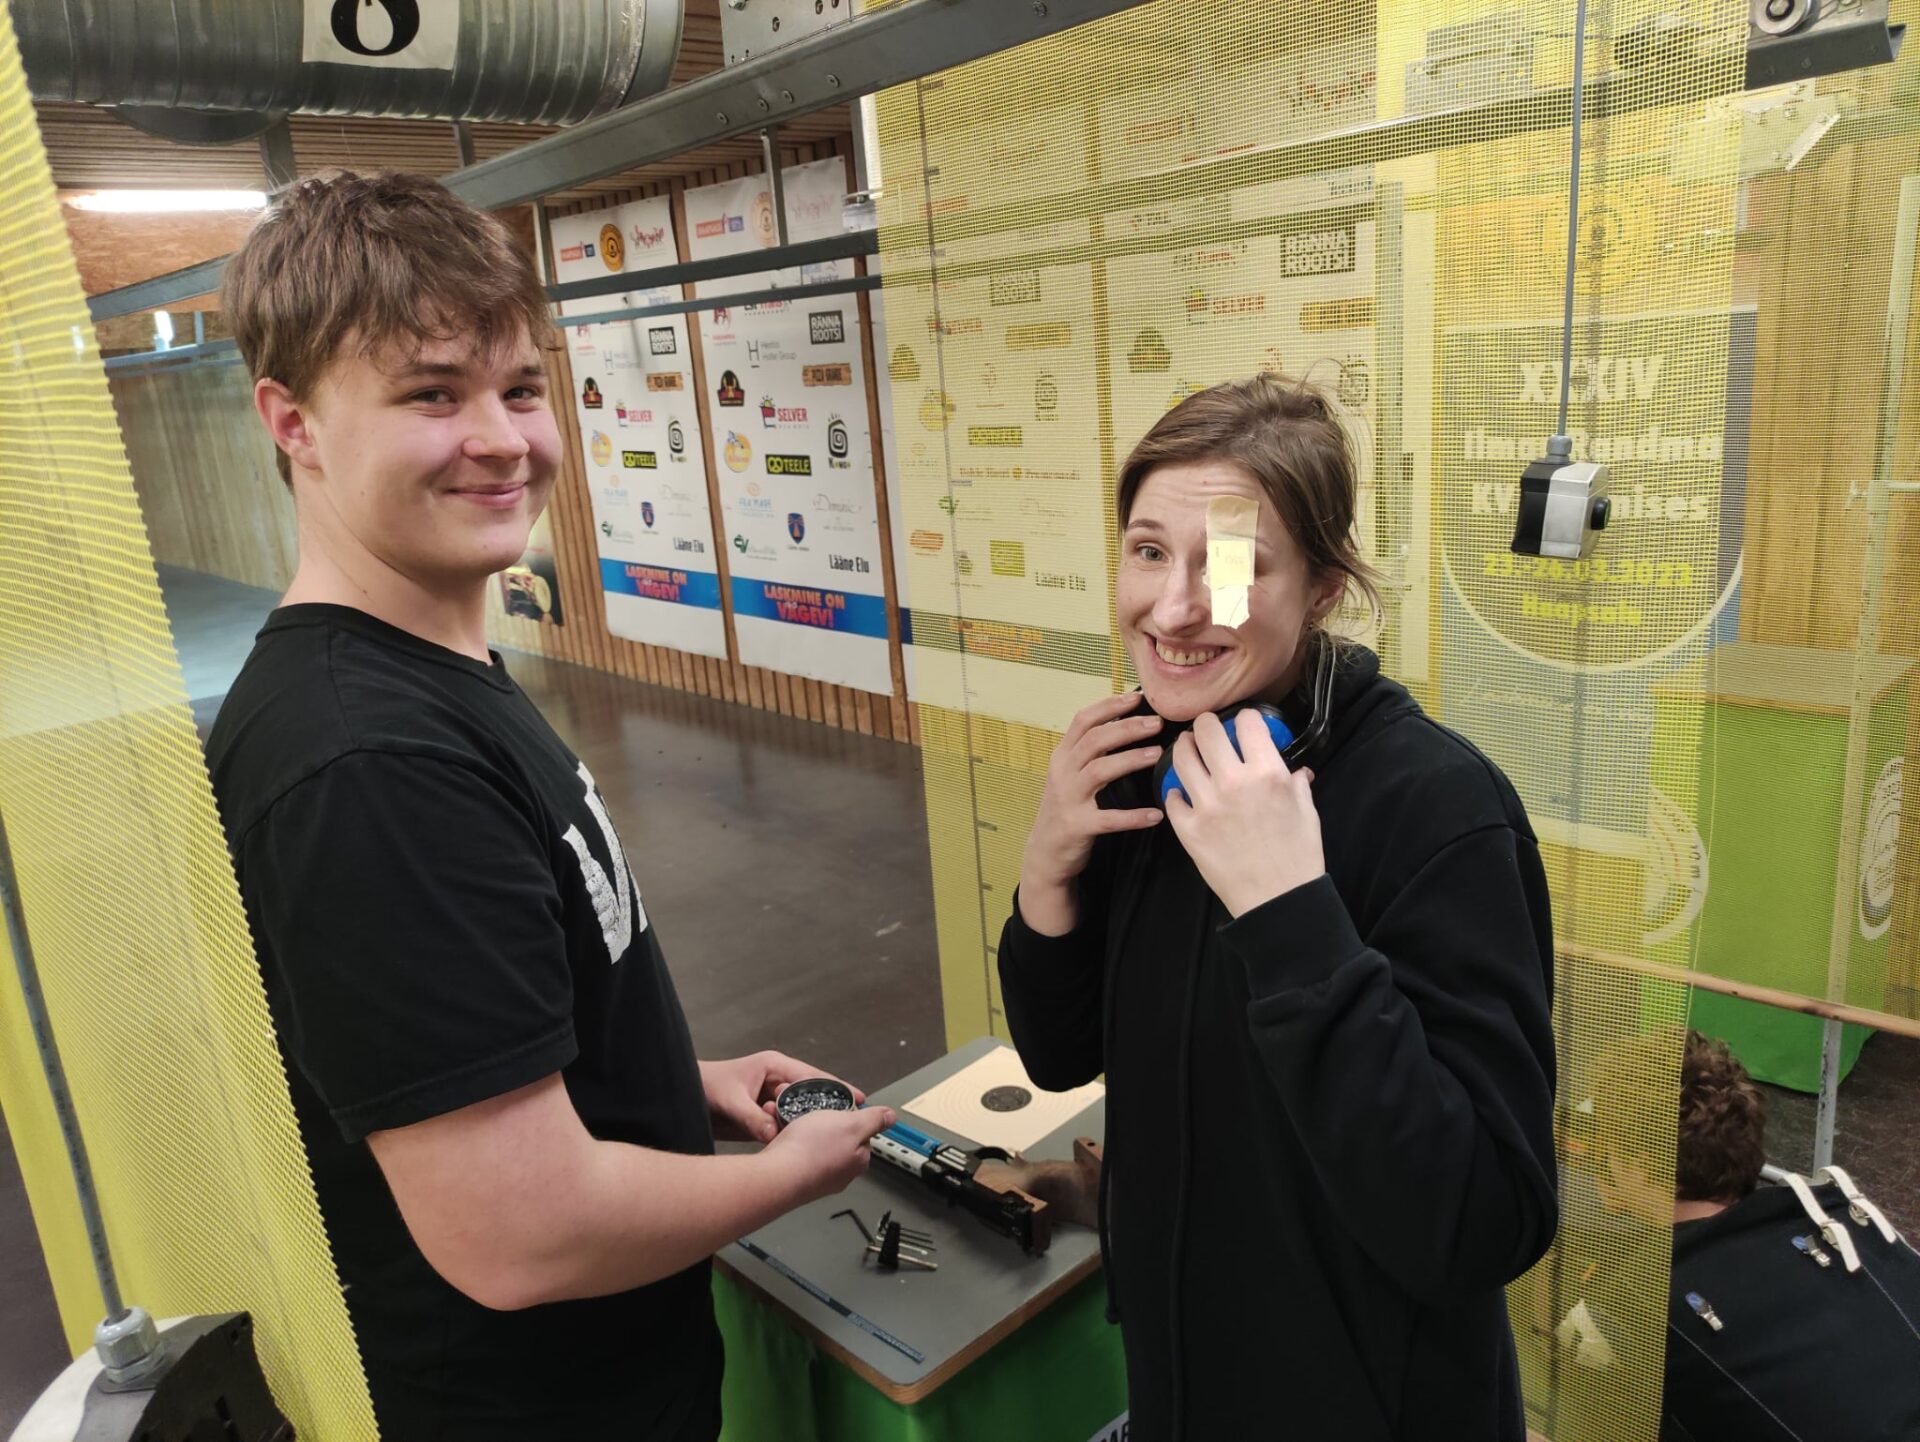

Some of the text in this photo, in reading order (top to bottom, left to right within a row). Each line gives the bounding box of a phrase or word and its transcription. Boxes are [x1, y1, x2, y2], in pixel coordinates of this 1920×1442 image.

[1520, 356, 1664, 402] XXXIV
[777, 407, 808, 422] SELVER
[828, 553, 870, 573] Lääne Elu
[764, 584, 845, 610] LASKMINE ON
